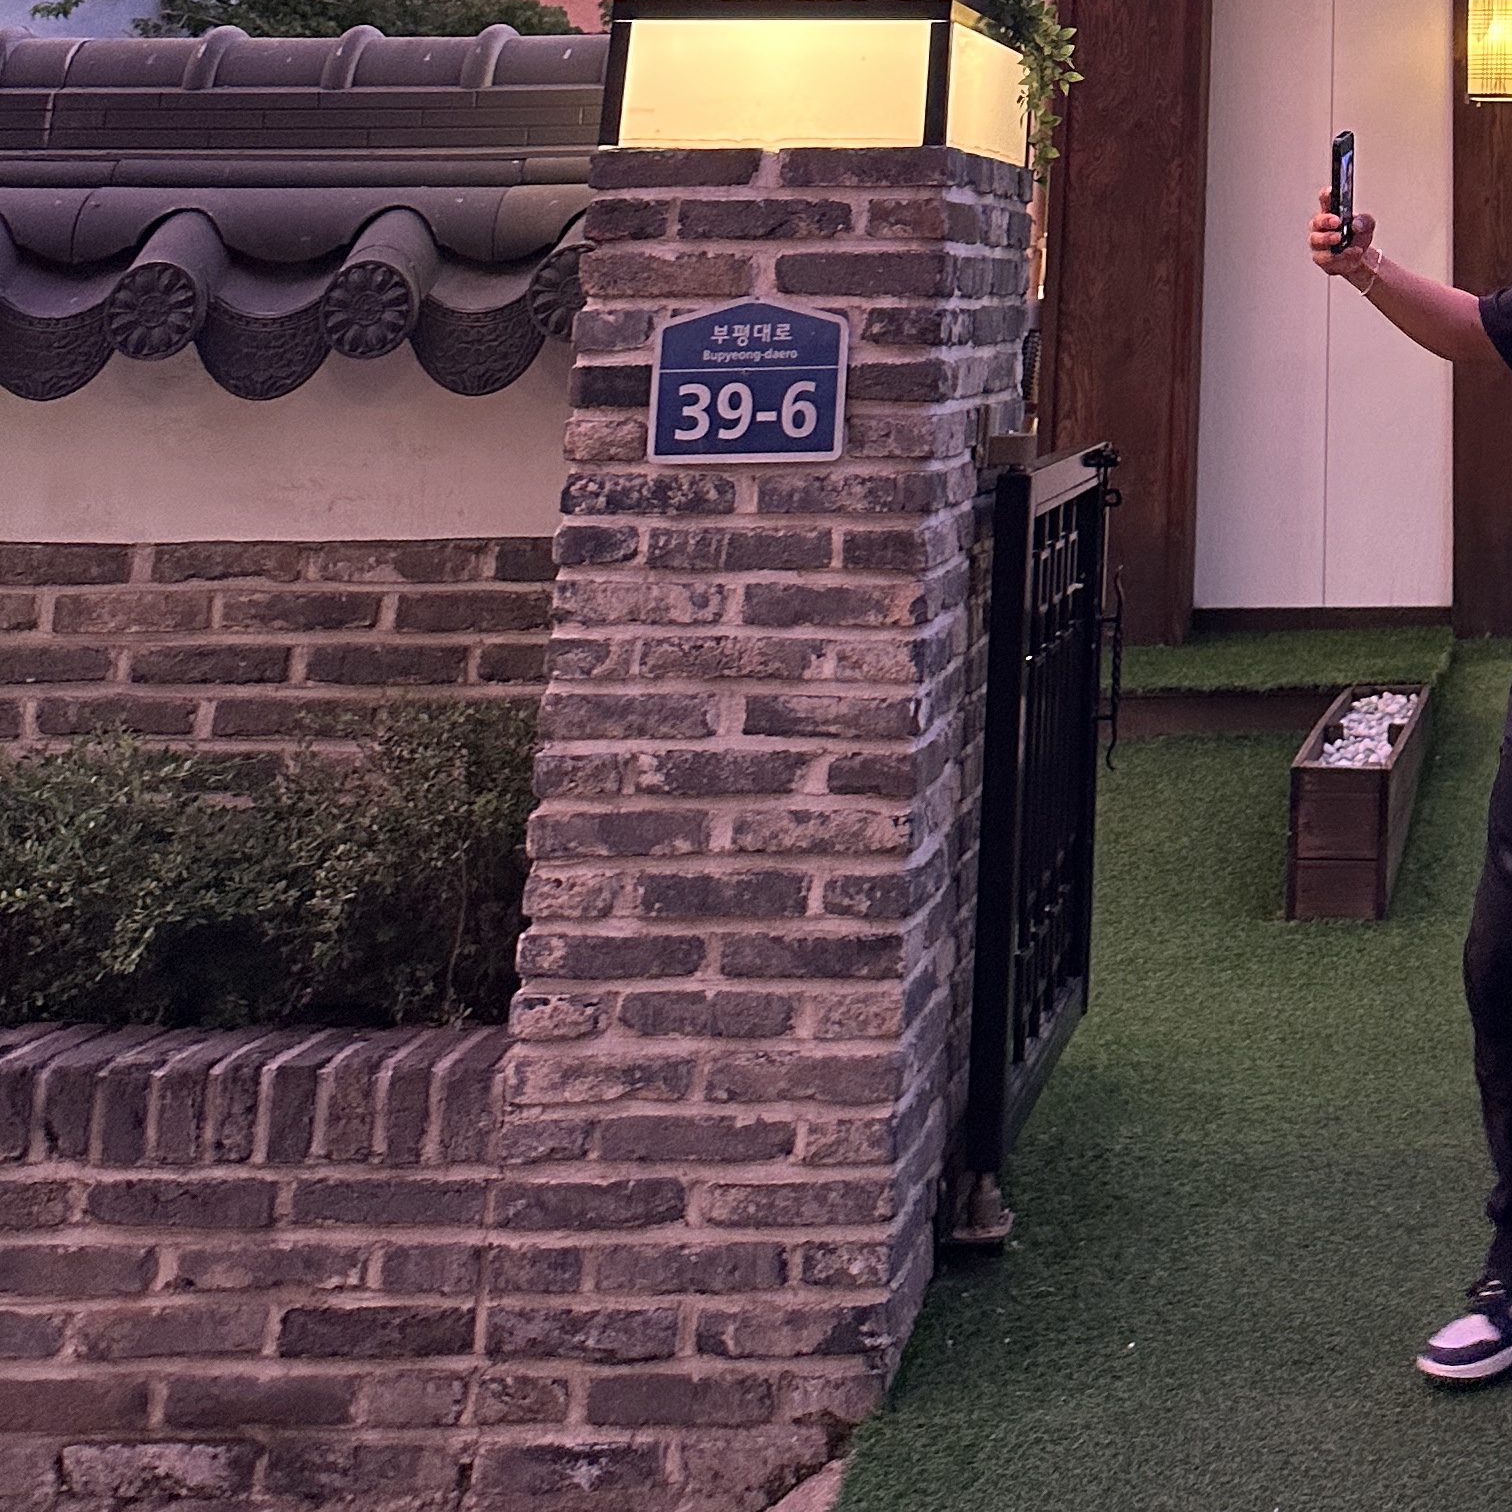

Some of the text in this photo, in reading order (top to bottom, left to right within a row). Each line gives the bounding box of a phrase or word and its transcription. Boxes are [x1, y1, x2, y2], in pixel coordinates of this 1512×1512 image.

[710, 323, 793, 346] 부평대로
[703, 348, 798, 363] Bupyeong-daero
[674, 380, 818, 441] 39-6
